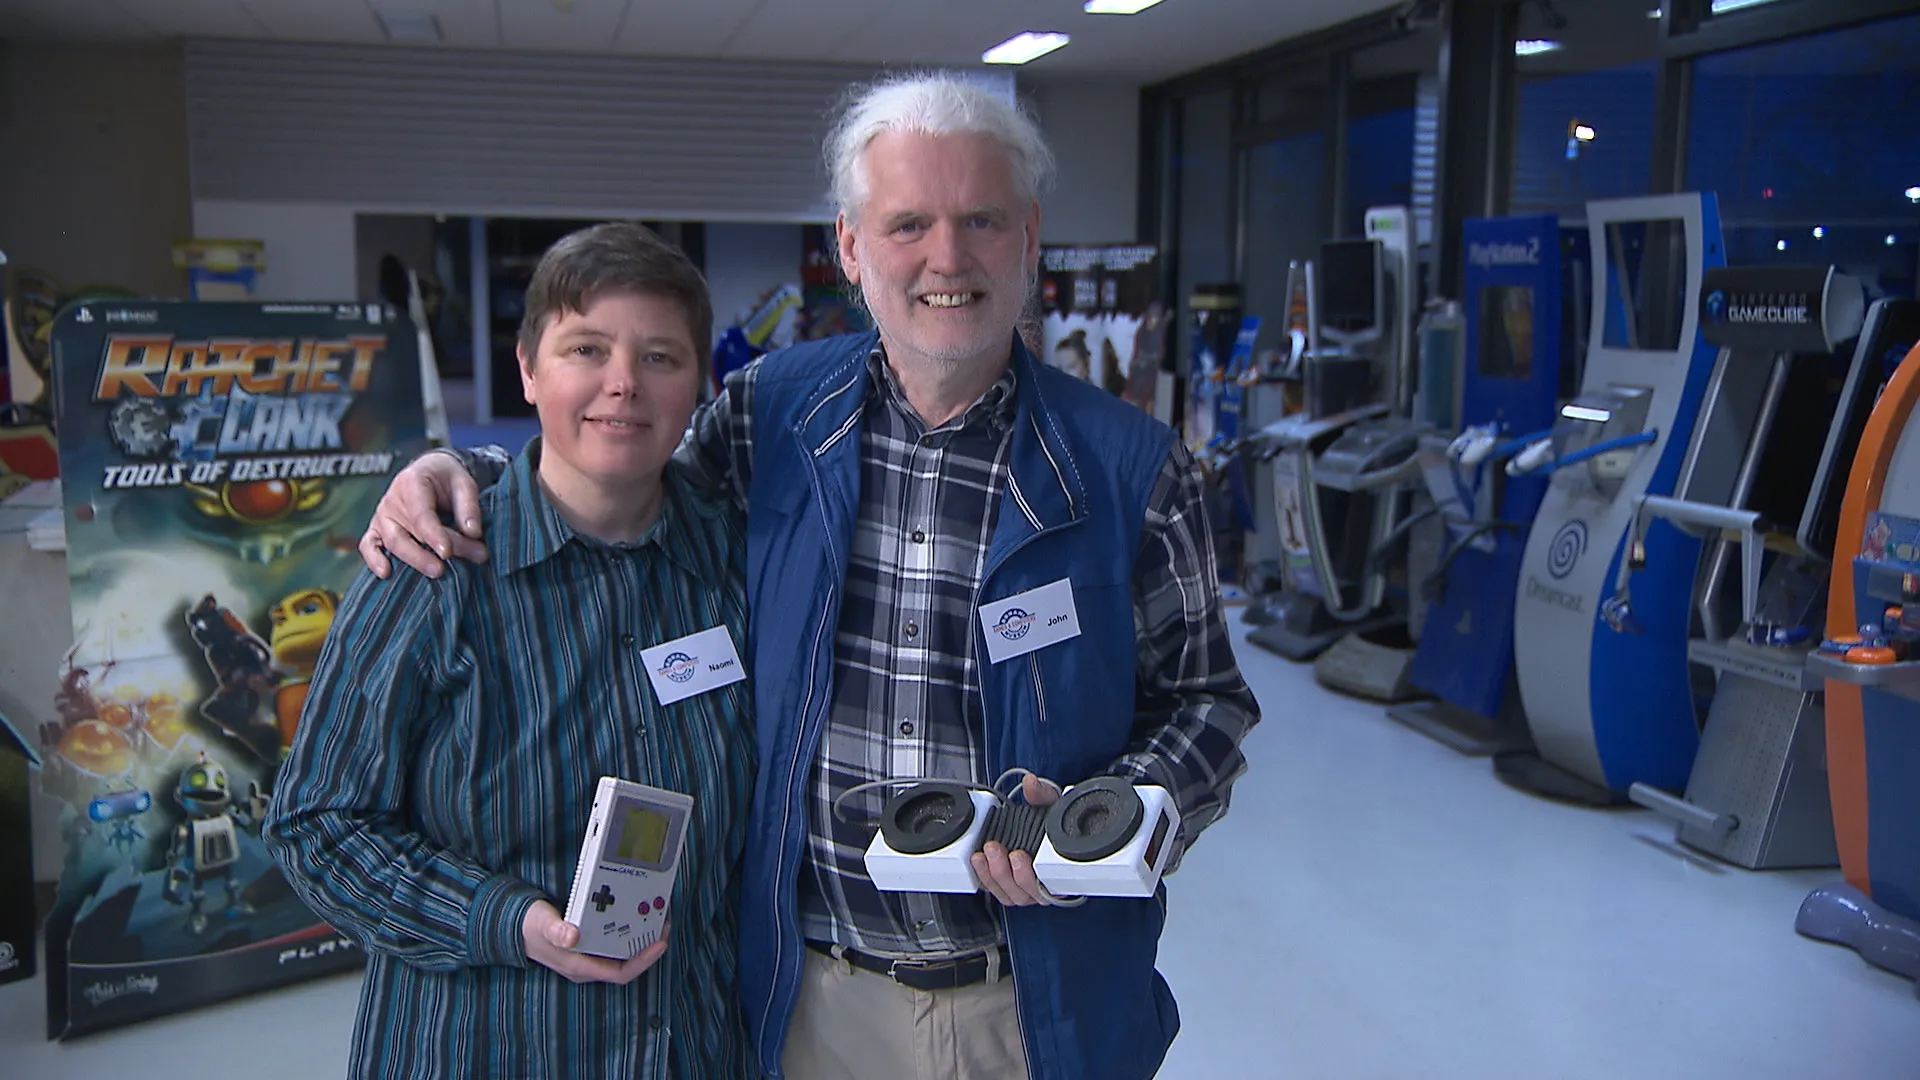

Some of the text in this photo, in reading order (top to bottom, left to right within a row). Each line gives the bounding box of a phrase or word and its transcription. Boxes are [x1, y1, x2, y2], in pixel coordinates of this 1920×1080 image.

[1728, 305, 1808, 322] GAMECUBE
[95, 333, 386, 400] RATCHET
[170, 396, 353, 461] CLANK
[103, 452, 394, 488] TOOLS OF DESTRUCTION
[1047, 614, 1068, 627] John
[708, 658, 735, 672] Naomi
